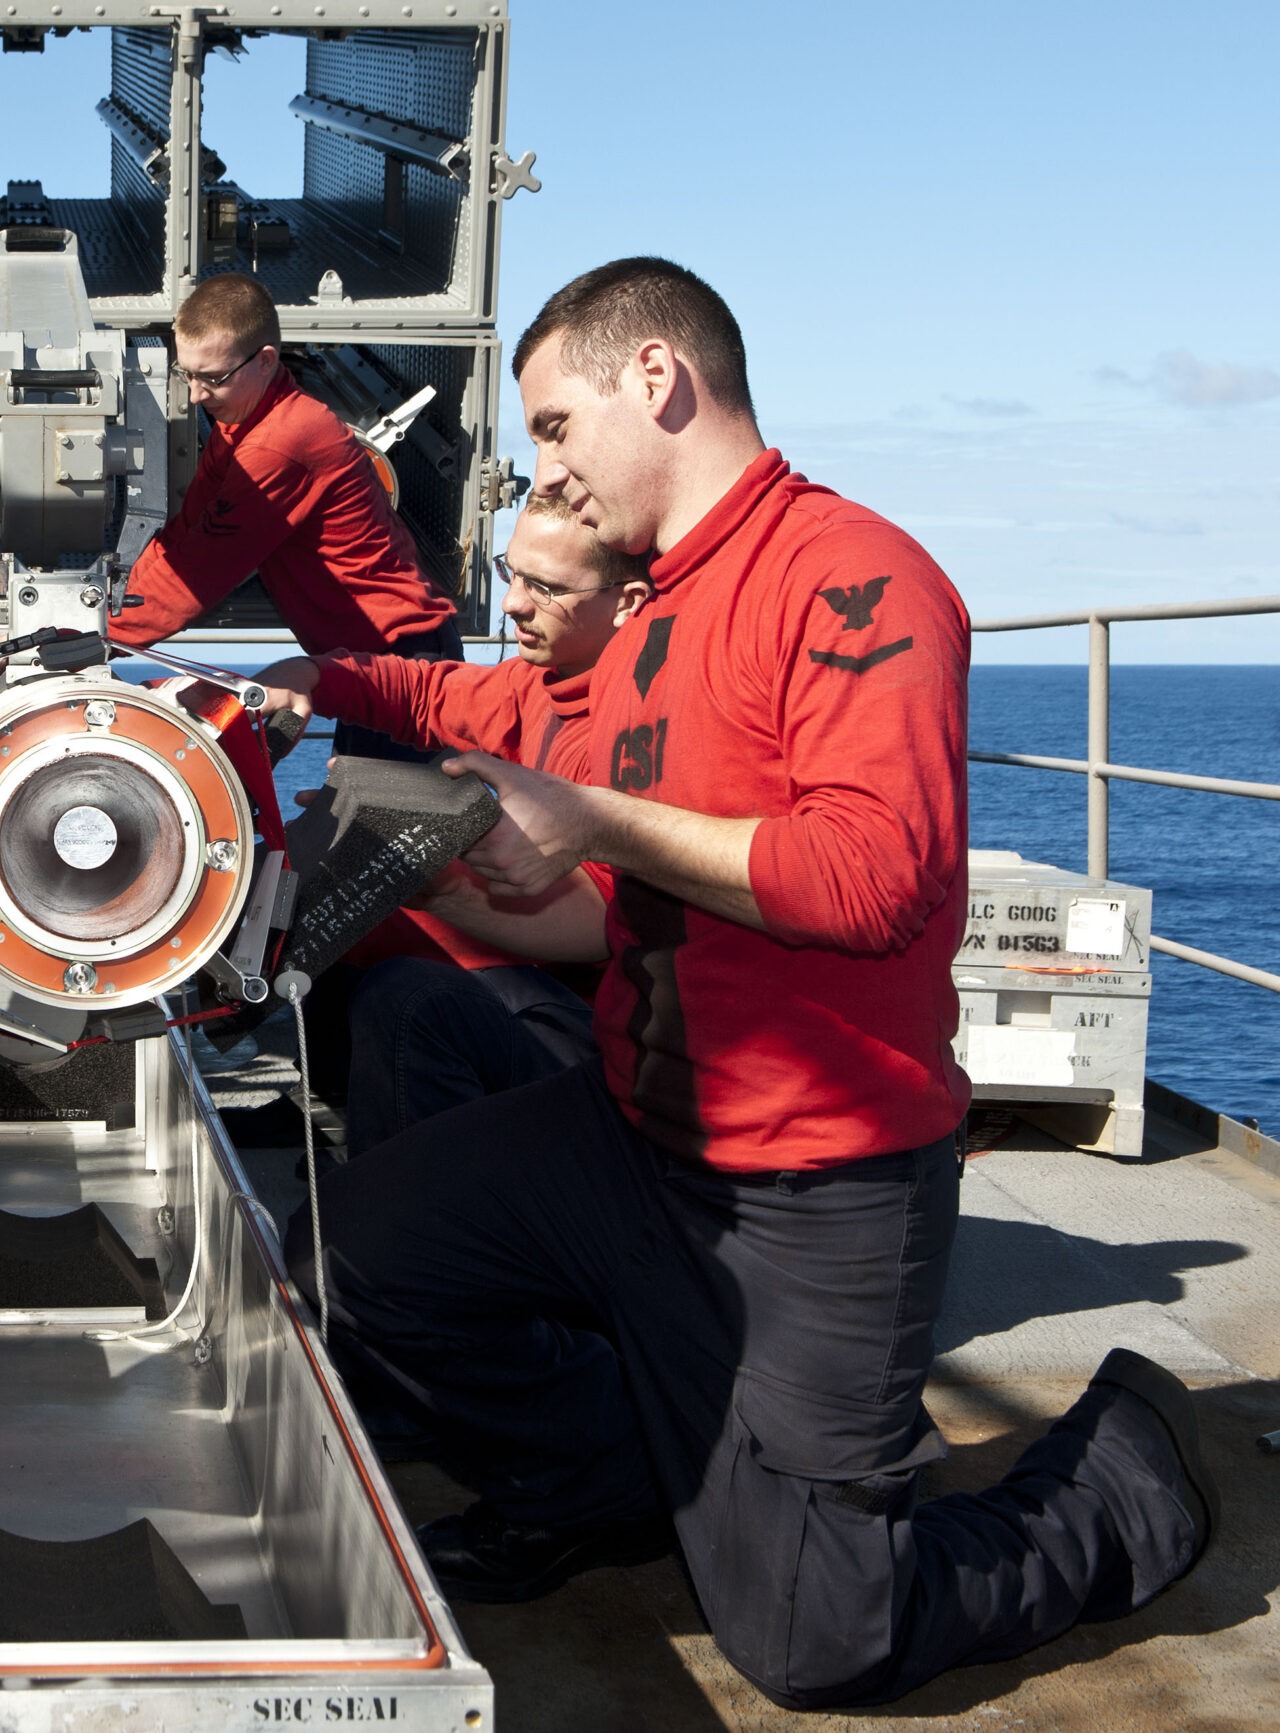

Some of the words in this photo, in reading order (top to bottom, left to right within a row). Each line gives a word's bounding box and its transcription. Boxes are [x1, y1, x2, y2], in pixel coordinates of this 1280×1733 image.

[967, 903, 995, 920] LC
[1008, 905, 1057, 922] 6006
[1098, 976, 1124, 985] SEAL
[1074, 1012, 1115, 1028] AFT
[253, 1697, 312, 1722] SEC
[325, 1697, 405, 1721] SEAL
